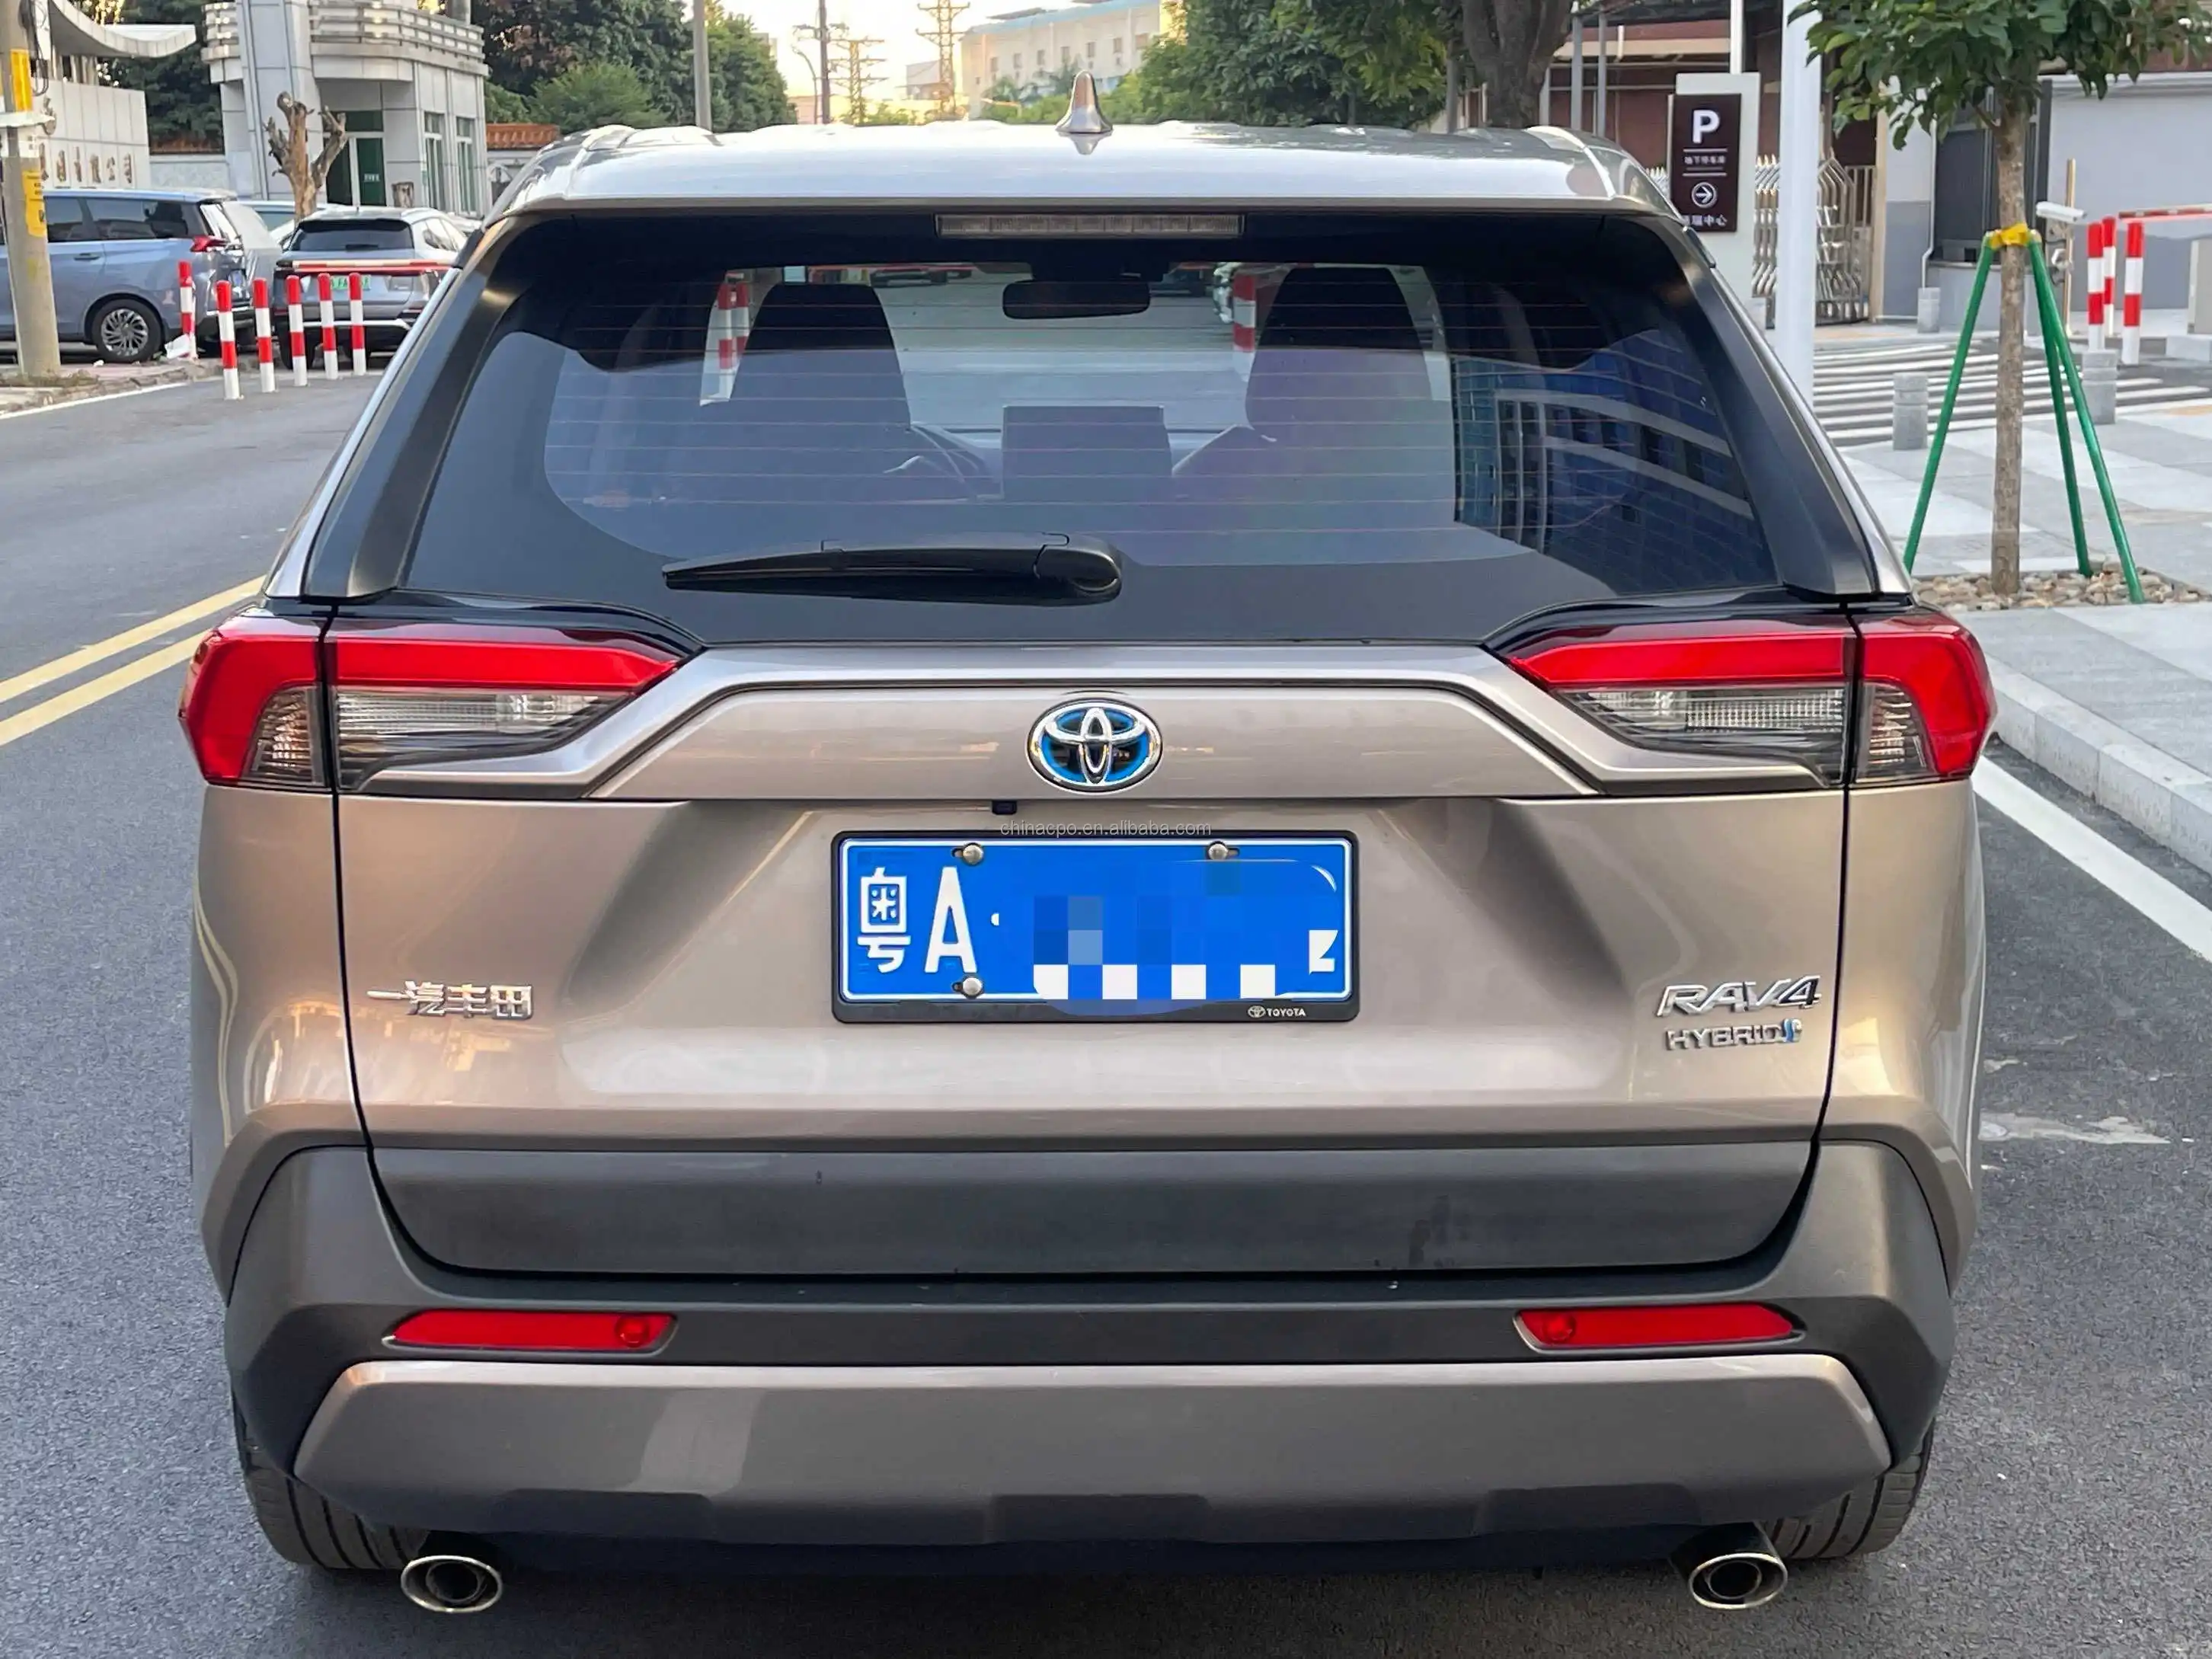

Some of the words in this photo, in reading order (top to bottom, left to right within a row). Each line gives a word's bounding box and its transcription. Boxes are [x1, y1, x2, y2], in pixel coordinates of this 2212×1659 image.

[1693, 109, 1720, 144] P
[366, 980, 532, 1020] 一汽丰田
[1266, 1008, 1306, 1017] TOYOTA
[1655, 975, 1822, 1017] RAV4
[1664, 1024, 1782, 1050] HYBRID
